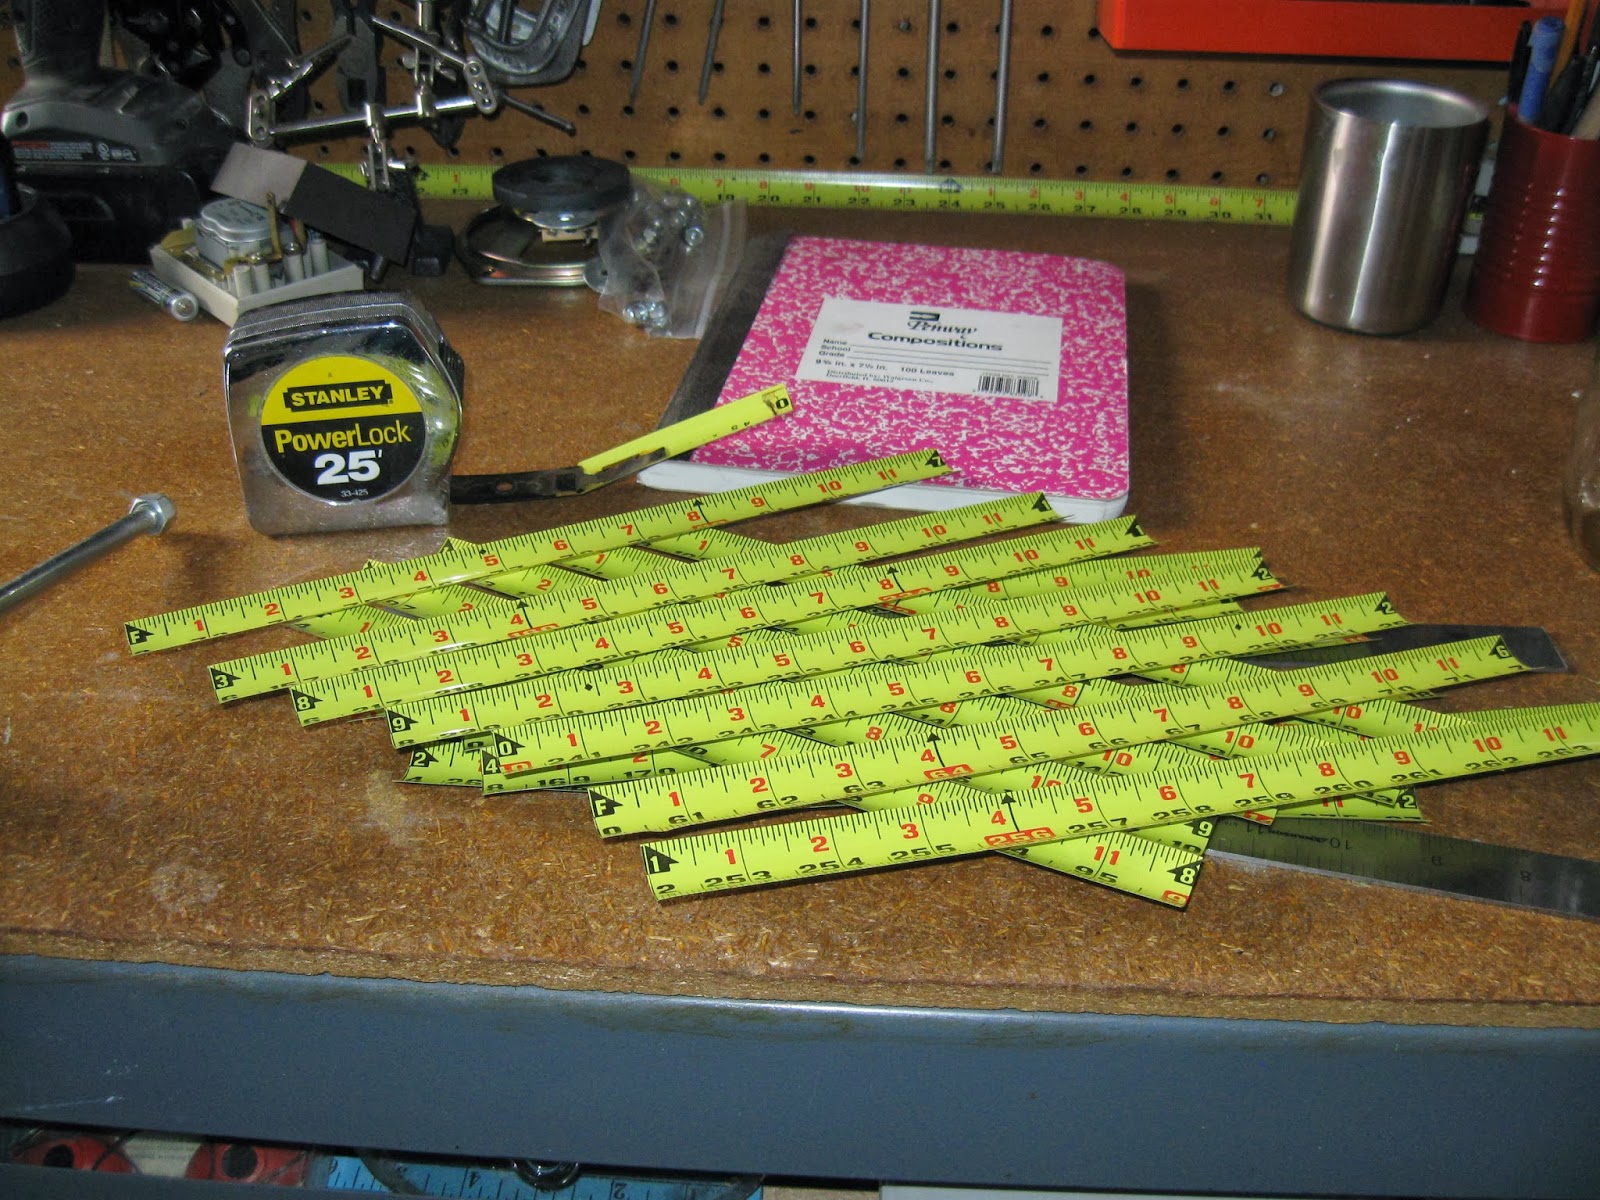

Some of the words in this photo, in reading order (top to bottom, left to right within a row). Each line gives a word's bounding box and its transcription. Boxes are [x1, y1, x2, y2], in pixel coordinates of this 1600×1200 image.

[1028, 203, 1050, 211] 26
[1073, 205, 1095, 213] 27
[1254, 212, 1273, 220] 31
[821, 344, 852, 352] School
[823, 338, 848, 346] Name
[868, 331, 1003, 351] Compositions
[818, 350, 845, 358] Grade
[900, 366, 917, 374] 100
[919, 368, 955, 377] Leaves
[290, 385, 384, 407] STANLEY
[274, 419, 412, 453] PowerLock
[340, 488, 369, 498] 33-425
[131, 632, 140, 643] F
[192, 619, 205, 632] 1
[264, 603, 278, 616] 2
[340, 587, 355, 598] 3
[415, 570, 428, 582] 4
[483, 555, 500, 566] 5
[553, 540, 568, 551] 6
[621, 524, 634, 535] 7
[687, 511, 701, 521] 8
[751, 497, 765, 507] 9
[816, 480, 842, 493] 10
[876, 469, 897, 480] 11
[538, 579, 551, 590] 2
[1055, 577, 1068, 587] 9
[215, 675, 229, 688] 3
[279, 663, 292, 676] 1
[355, 646, 369, 660] 2
[433, 629, 449, 643] 3
[511, 614, 524, 625] 4
[581, 597, 598, 610] 5
[653, 583, 669, 595] 6
[720, 567, 735, 580] 7
[790, 554, 805, 566] 8
[854, 541, 869, 552] 9
[921, 525, 947, 538] 10
[981, 513, 1002, 524] 11
[297, 696, 311, 710] 8
[361, 684, 373, 698] 1
[437, 669, 453, 684] 2
[517, 653, 533, 667] 3
[596, 637, 610, 649] 4
[668, 621, 684, 635] 5
[740, 607, 757, 619] 6
[810, 591, 824, 604] 7
[879, 578, 894, 590] 8
[945, 565, 960, 576] 9
[1012, 549, 1039, 562] 10
[1073, 538, 1095, 549] 11
[392, 717, 405, 731] 9
[458, 708, 471, 722] 1
[536, 693, 552, 709] 2
[617, 680, 634, 695] 3
[698, 667, 713, 680] 4
[774, 654, 791, 667] 5
[849, 640, 866, 653] 6
[921, 627, 936, 640] 7
[994, 616, 1009, 628] 8
[1063, 605, 1078, 616] 9
[1133, 590, 1161, 603] 10
[1197, 579, 1219, 591] 11
[500, 741, 513, 756] 0
[565, 732, 578, 747] 1
[645, 720, 661, 736] 2
[728, 707, 745, 721] 3
[810, 694, 825, 708] 4
[888, 682, 905, 696] 5
[965, 670, 982, 684] 6
[1038, 658, 1053, 671] 7
[1112, 647, 1128, 660] 8
[1182, 636, 1198, 648] 9
[1254, 623, 1283, 636] 10
[1319, 613, 1342, 625] 11
[1062, 685, 1077, 698] 8
[596, 800, 608, 816] F
[667, 791, 681, 807] 1
[750, 777, 768, 794] 2
[835, 762, 853, 779] 3
[921, 748, 936, 763] 4
[999, 735, 1018, 750] 5
[1078, 722, 1096, 736] 6
[1151, 708, 1168, 723] 7
[1227, 696, 1244, 710] 8
[1298, 684, 1315, 697] 9
[1369, 668, 1399, 683] 10
[1435, 657, 1458, 671] 11
[866, 726, 883, 741] 8
[1223, 730, 1255, 749] 10
[414, 752, 426, 766] 2
[486, 758, 498, 772] 4
[1101, 749, 1133, 767] 10
[668, 811, 705, 825] 61
[756, 795, 799, 809] 62
[843, 780, 885, 794] 63
[928, 764, 972, 778] 64
[1009, 752, 1051, 765] 65
[1088, 737, 1131, 751] 66
[1165, 723, 1201, 736] 67
[1239, 710, 1278, 722] 68
[537, 775, 591, 787] 169
[649, 855, 661, 873] 1
[723, 849, 737, 865] 1
[810, 835, 829, 853] 2
[901, 822, 920, 840] 3
[991, 810, 1007, 825] 4
[1074, 797, 1094, 814] 5
[1159, 785, 1177, 801] 6
[1238, 773, 1255, 789] 7
[1318, 761, 1336, 777] 8
[1393, 751, 1411, 765] 9
[1471, 736, 1502, 753] 10
[1541, 726, 1567, 741] 11
[1401, 794, 1415, 809] 2
[656, 884, 676, 895] 2
[704, 870, 773, 887] 253
[799, 857, 866, 874] 254
[890, 843, 957, 860] 255
[986, 829, 1053, 845] 256
[1067, 817, 1129, 833] 257
[1152, 804, 1215, 820] 258
[1233, 792, 1296, 807] 259
[1313, 780, 1375, 795] 260
[1391, 768, 1444, 783] 261
[1198, 820, 1212, 837] 9
[1092, 845, 1120, 865] 11
[1180, 866, 1194, 884] 8
[1074, 865, 1119, 884] 95
